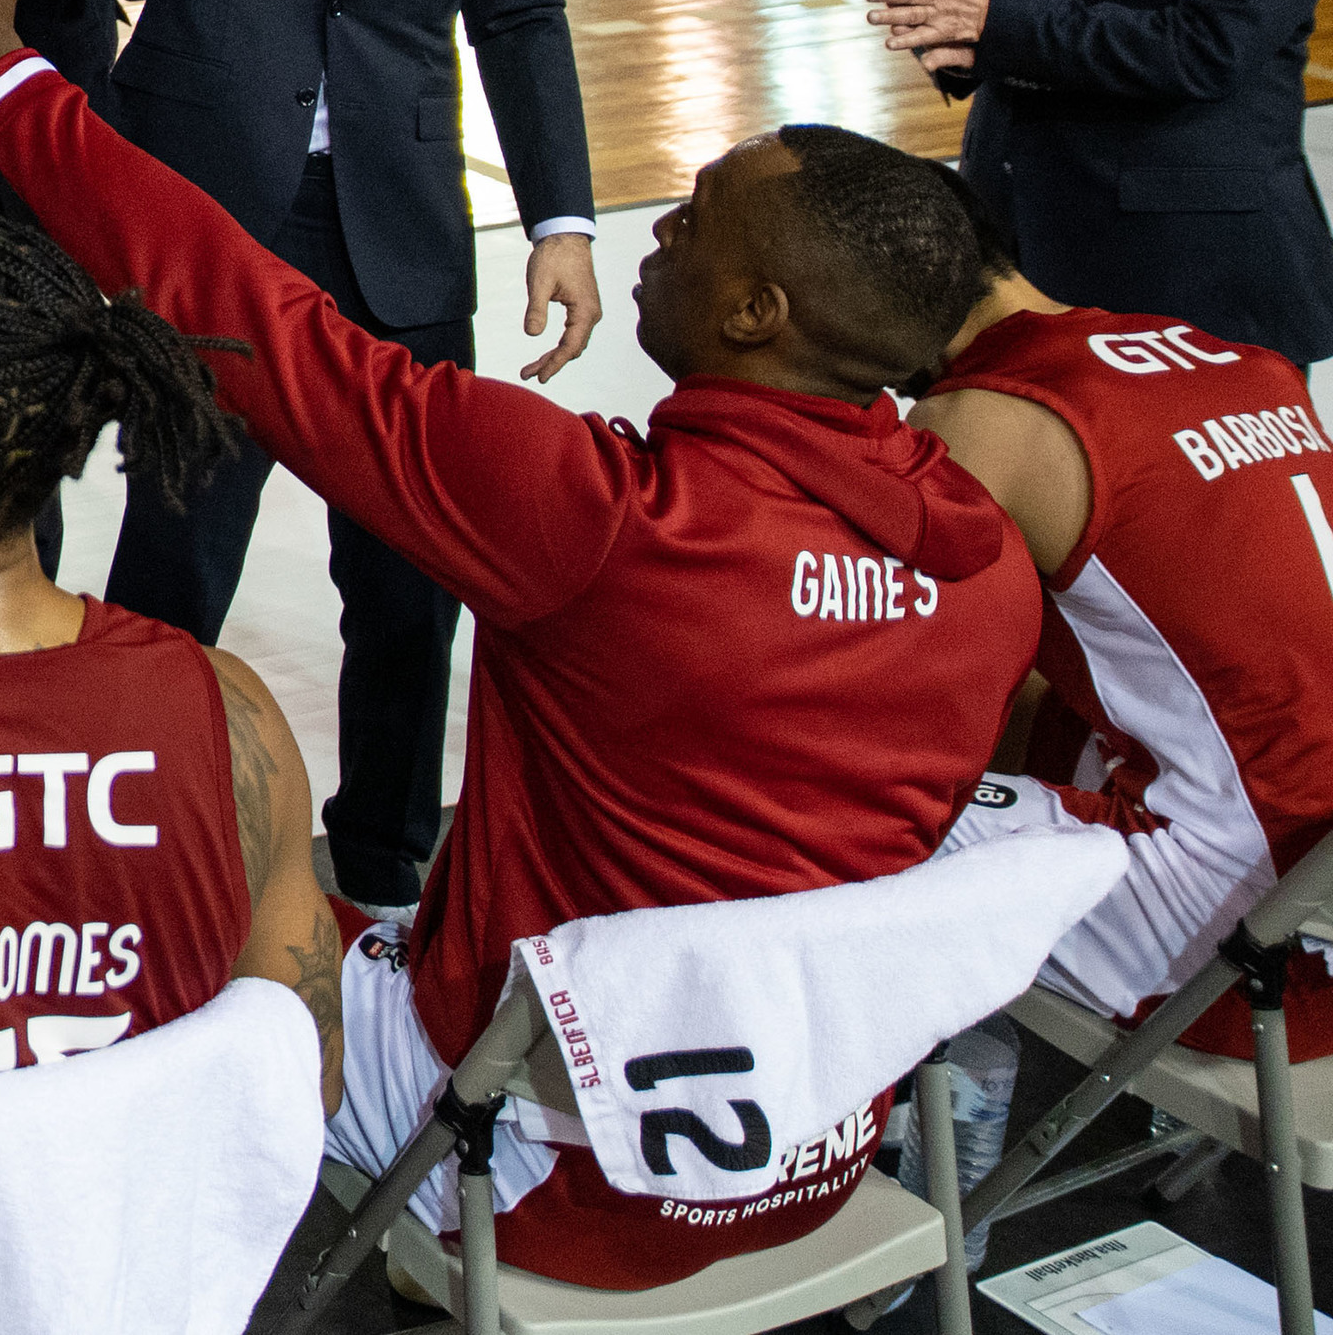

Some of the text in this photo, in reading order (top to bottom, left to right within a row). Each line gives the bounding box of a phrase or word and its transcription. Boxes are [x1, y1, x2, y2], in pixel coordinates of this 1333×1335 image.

[1087, 324, 1242, 374] GTC
[791, 550, 939, 623] GAINES
[777, 1099, 877, 1183] REME
[660, 1154, 870, 1225] SPORTS HOSPITALITY
